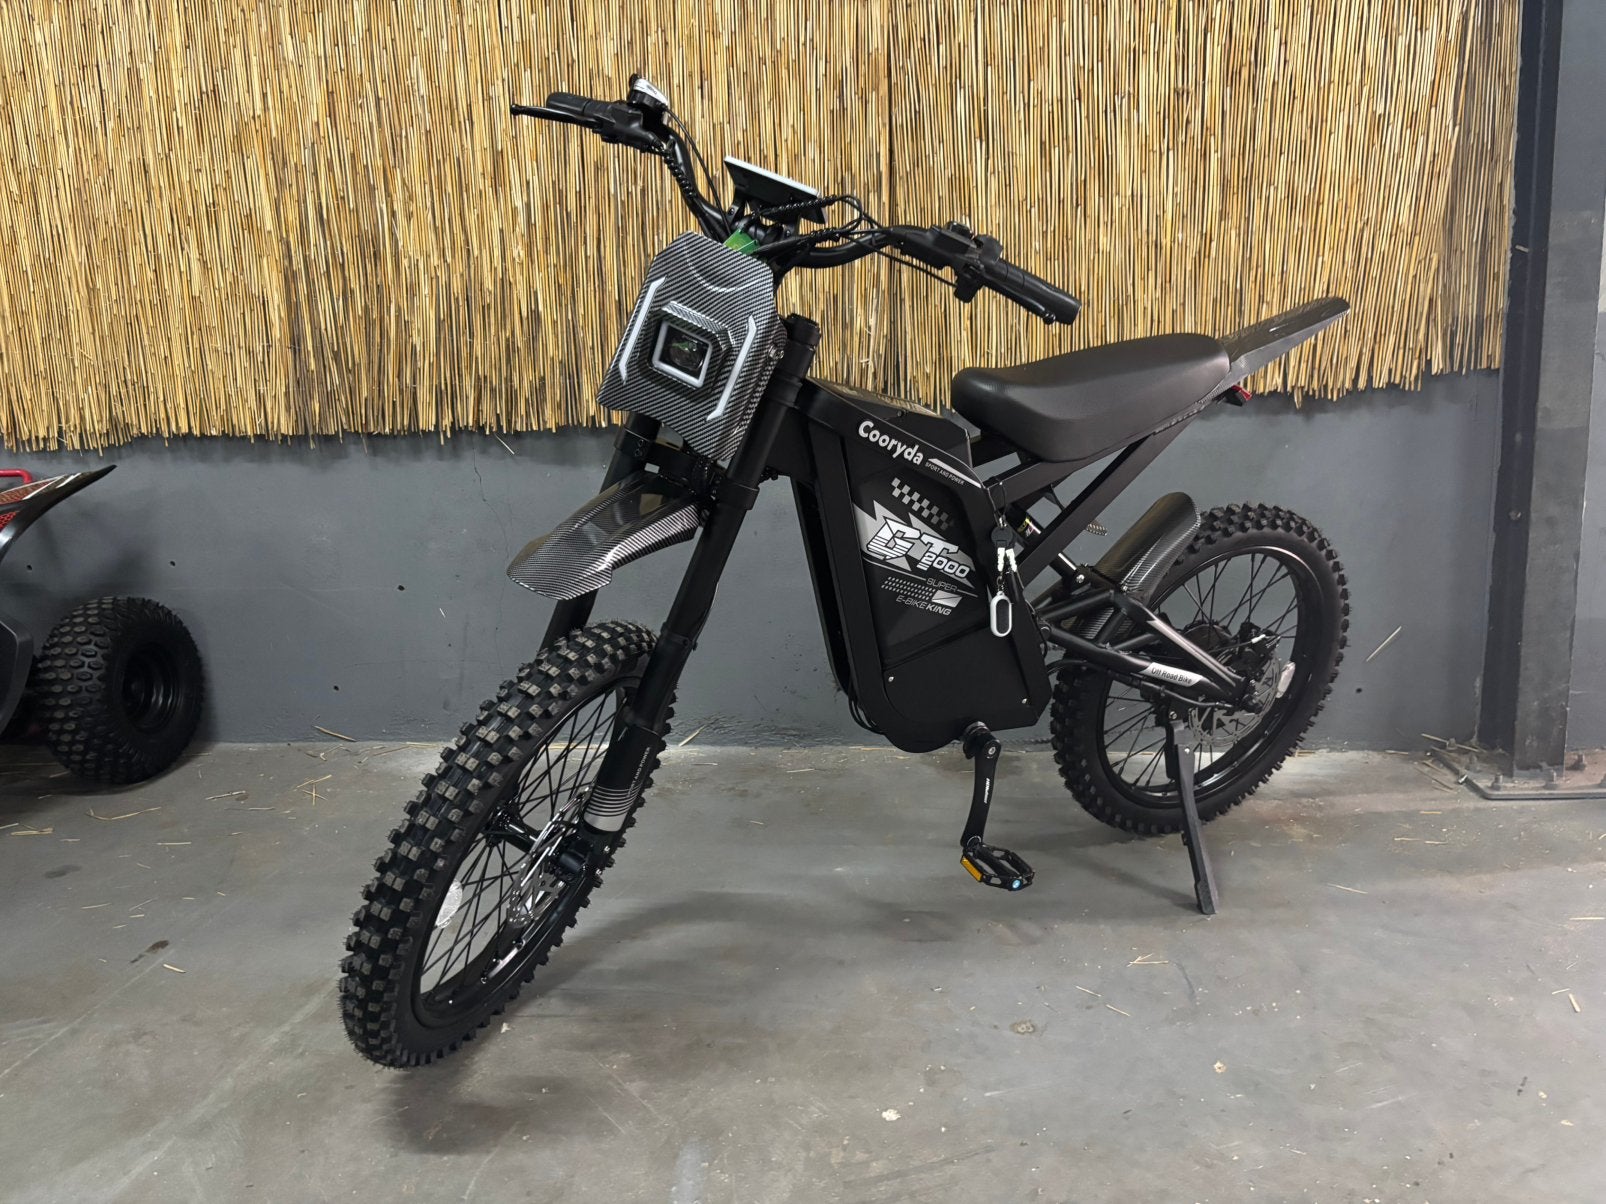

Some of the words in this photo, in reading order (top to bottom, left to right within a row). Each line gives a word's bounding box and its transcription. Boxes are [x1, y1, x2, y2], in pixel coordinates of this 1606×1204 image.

[858, 420, 924, 465] Cooryda
[916, 552, 970, 578] 2000
[926, 577, 958, 592] SUPER
[896, 594, 928, 609] E-BIKE
[925, 603, 952, 616] KING
[1161, 671, 1178, 681] Road
[1178, 675, 1192, 684] Bike
